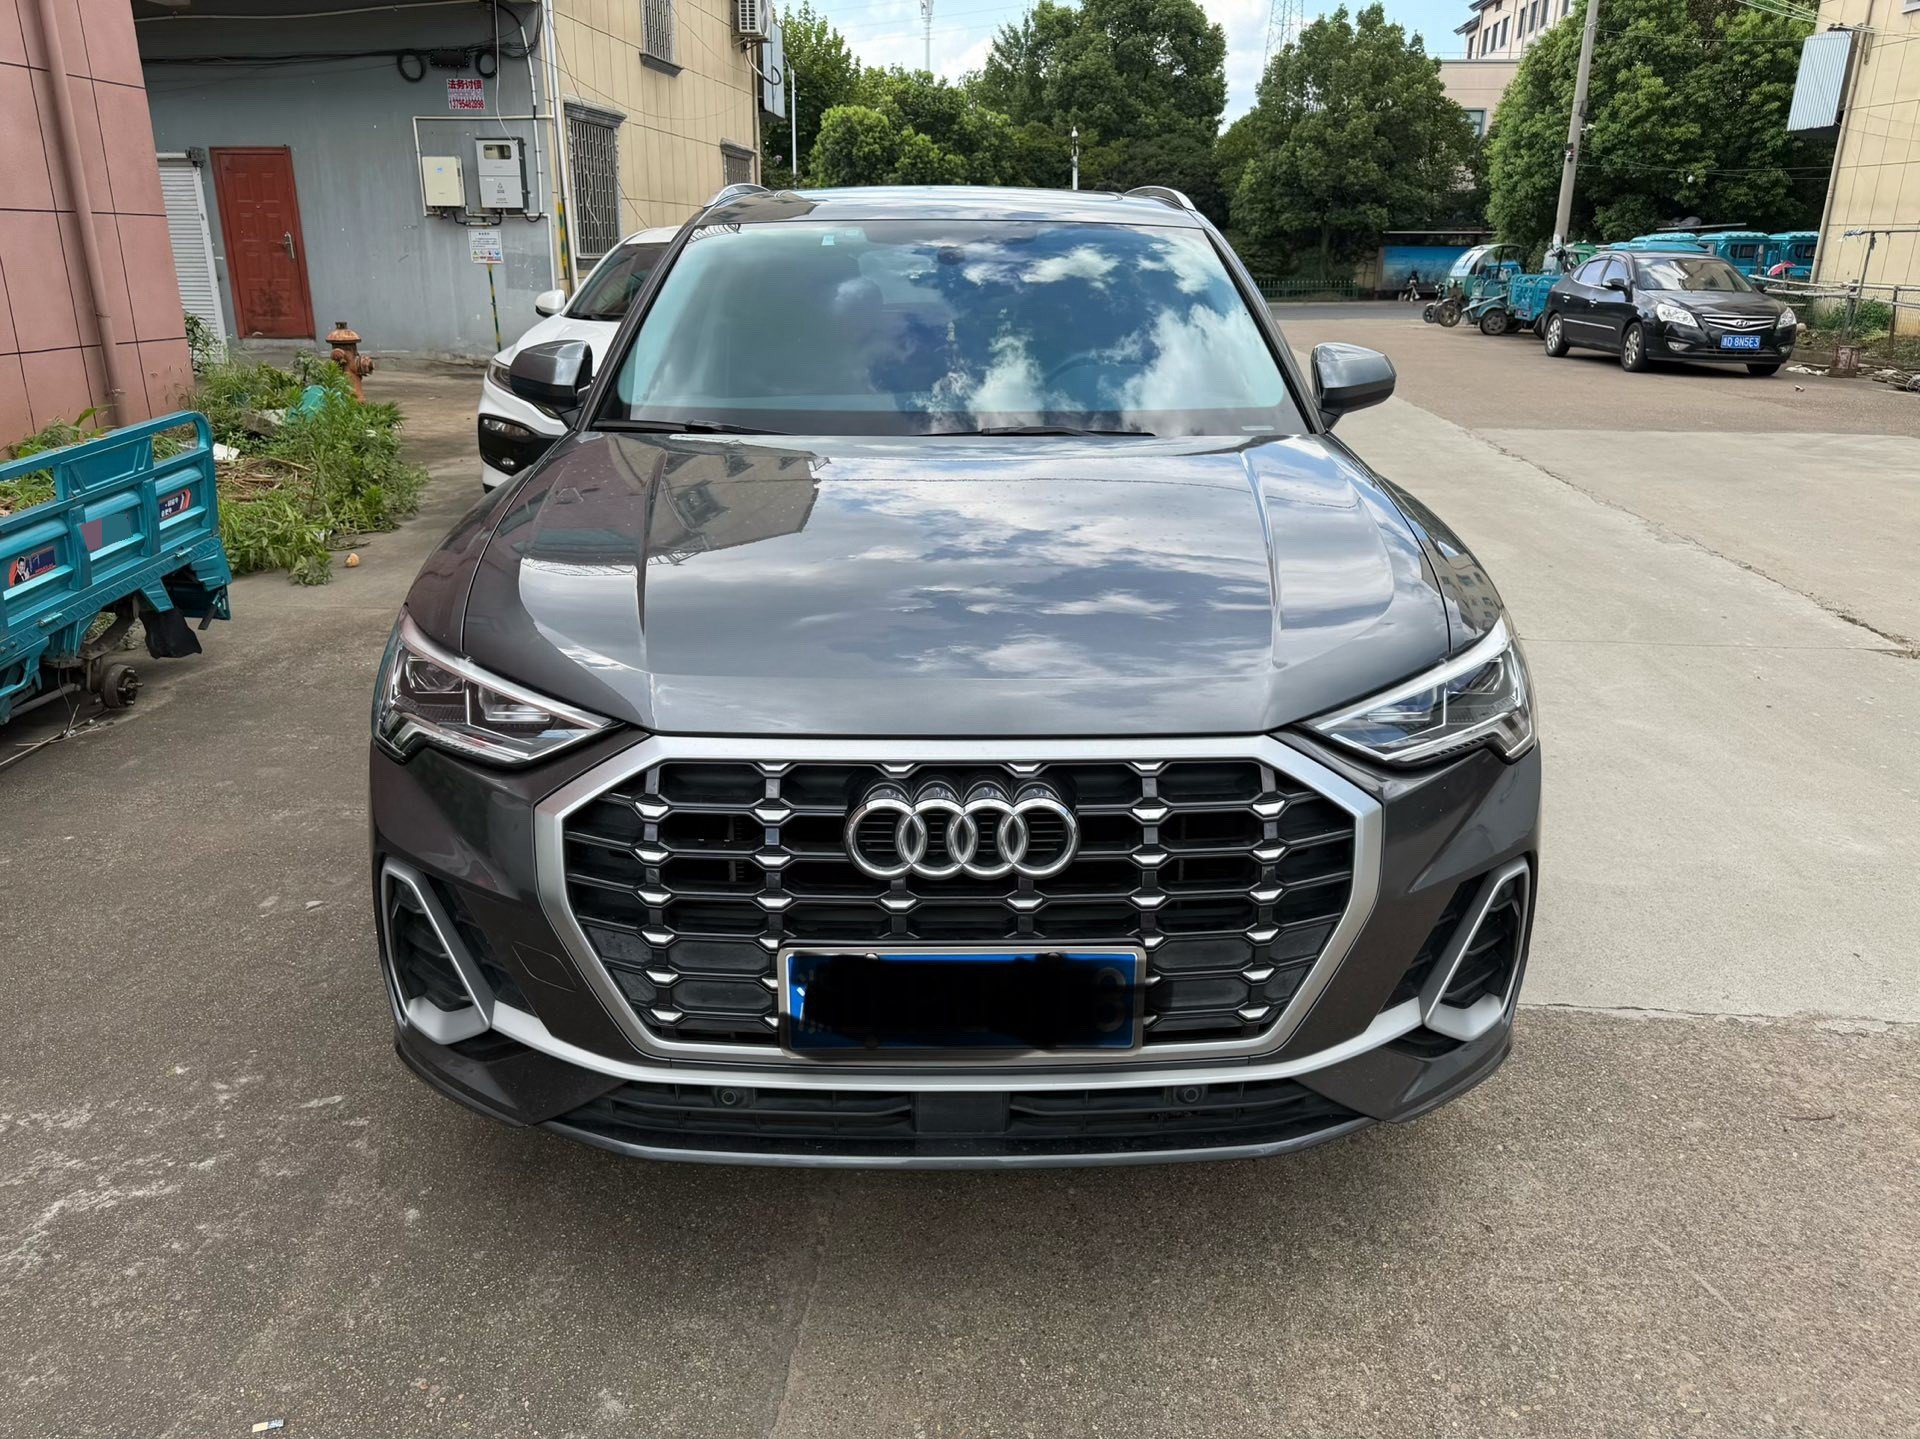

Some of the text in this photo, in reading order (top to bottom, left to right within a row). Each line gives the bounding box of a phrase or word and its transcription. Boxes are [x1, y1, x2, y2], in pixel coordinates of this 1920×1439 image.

[448, 79, 482, 89] 法务讨债
[1734, 336, 1759, 347] 8N5E3
